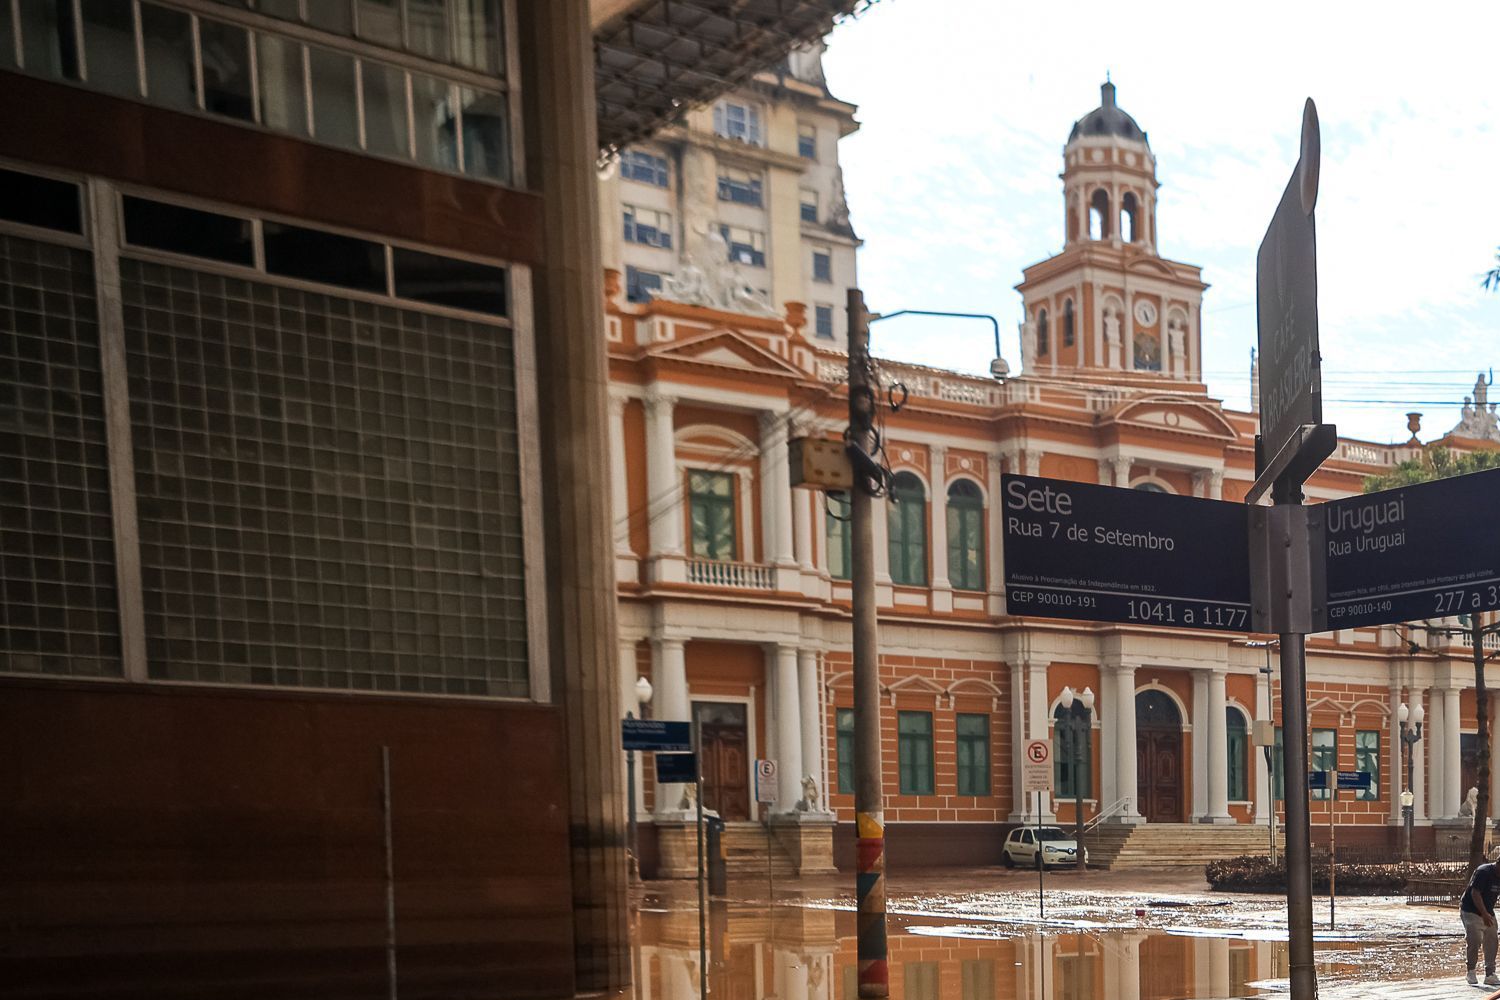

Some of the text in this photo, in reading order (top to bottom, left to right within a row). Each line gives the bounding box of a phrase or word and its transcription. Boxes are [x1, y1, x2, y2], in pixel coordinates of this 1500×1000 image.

[1007, 481, 1073, 516] Sete
[1328, 493, 1405, 534] Uruguai
[1008, 517, 1175, 552] Rua 7 de Setembro
[1329, 528, 1405, 557] Rua Uruguai
[1012, 591, 1097, 608] CEP 90010-191
[1331, 600, 1391, 618] CEP 90010-140
[1434, 590, 1465, 613] 277
[1471, 592, 1481, 609] a
[1127, 600, 1249, 629] 1041 a 1177
